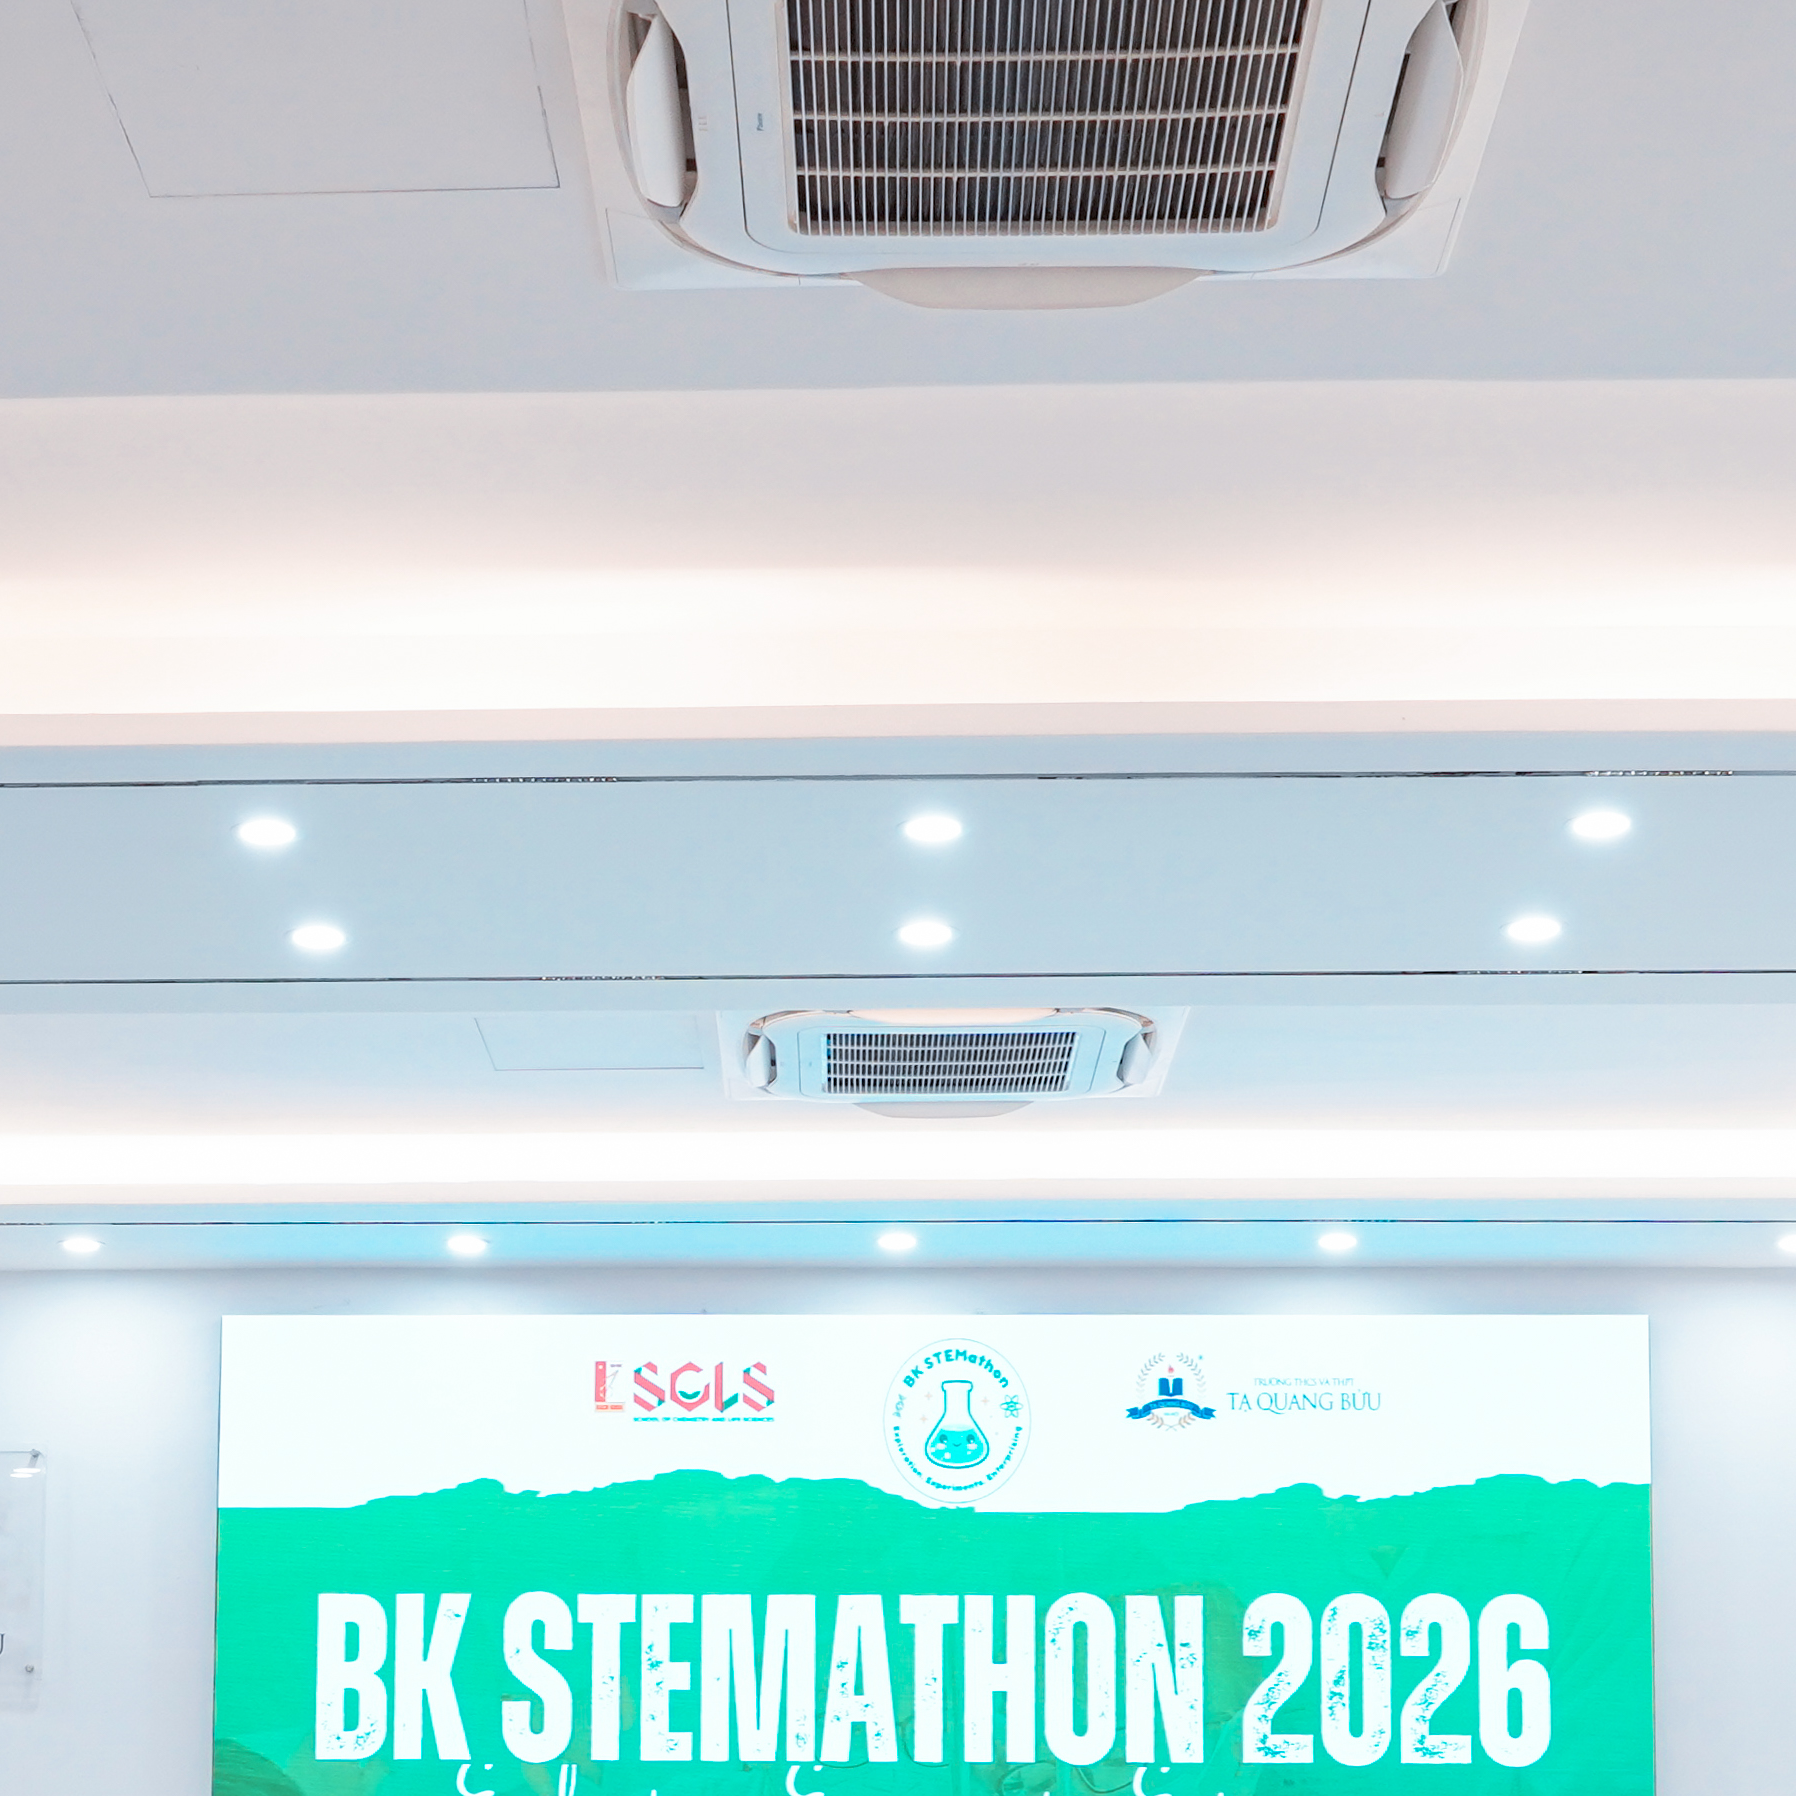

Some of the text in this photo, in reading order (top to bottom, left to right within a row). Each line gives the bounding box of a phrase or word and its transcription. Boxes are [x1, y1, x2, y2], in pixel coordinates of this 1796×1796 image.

[903, 1349, 1009, 1388] BK STEMathon
[1226, 1392, 1252, 1412] TẠ
[1257, 1392, 1333, 1414] QUANG
[314, 1590, 1553, 1767] BK STEMATHON 2026
